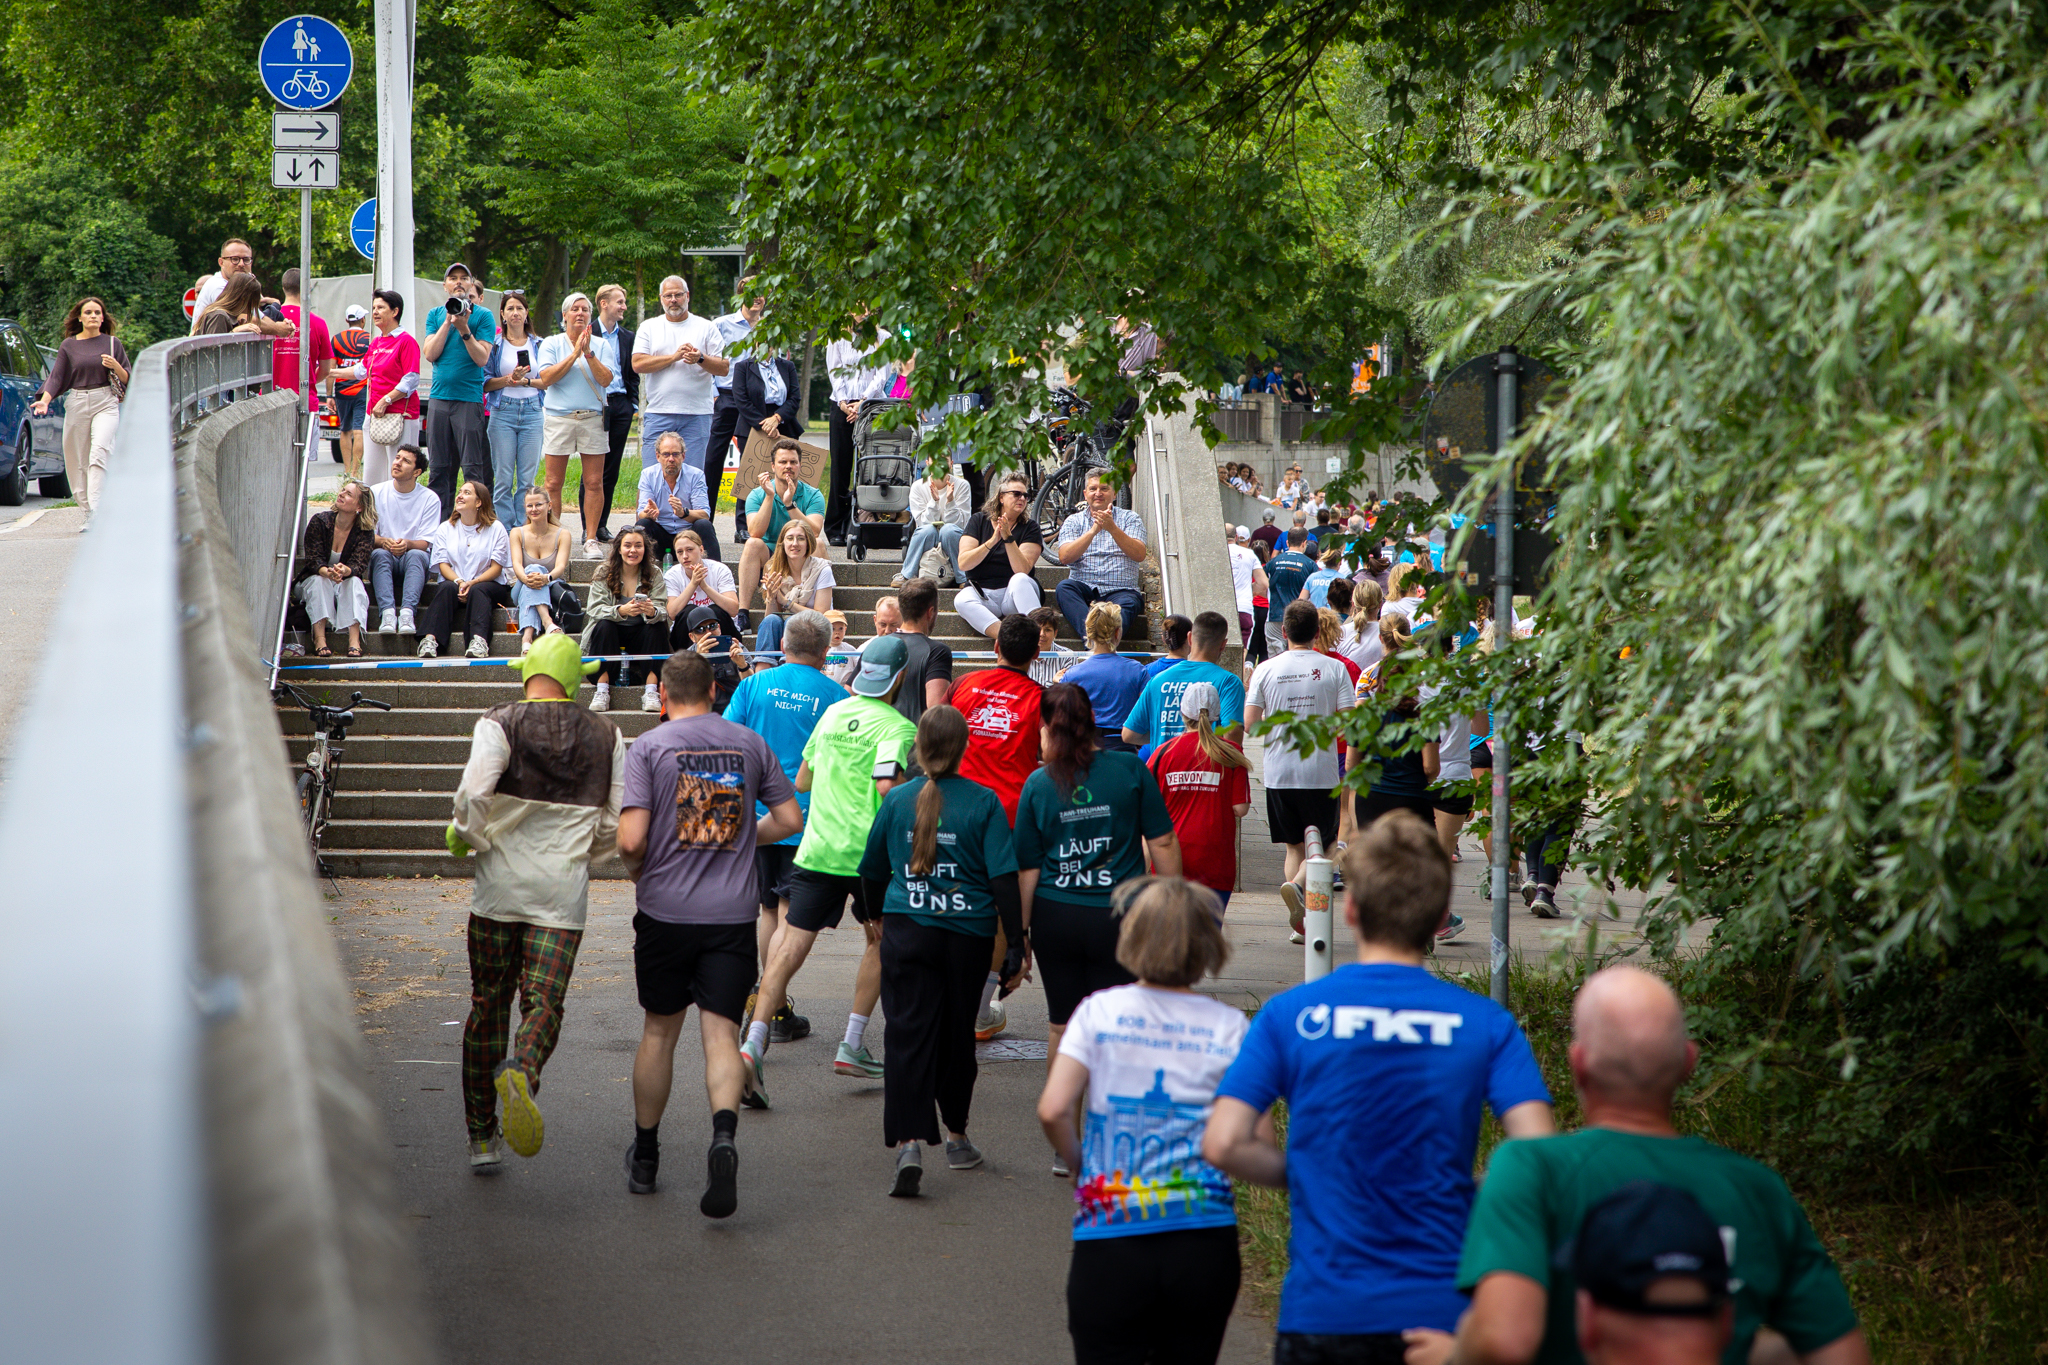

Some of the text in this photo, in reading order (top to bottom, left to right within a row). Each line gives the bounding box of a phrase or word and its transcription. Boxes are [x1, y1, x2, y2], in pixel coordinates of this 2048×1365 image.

[766, 687, 815, 703] HETZ MICH
[774, 700, 803, 712] NICHT
[676, 753, 745, 773] SCHOTTER
[1168, 773, 1203, 784] XERVON
[1059, 836, 1113, 858] LÄUFT
[904, 863, 958, 878] LUFT
[1059, 859, 1082, 874] BEI
[906, 881, 929, 892] BEI
[909, 891, 972, 911] UNS.
[1332, 1004, 1464, 1046] FKT
